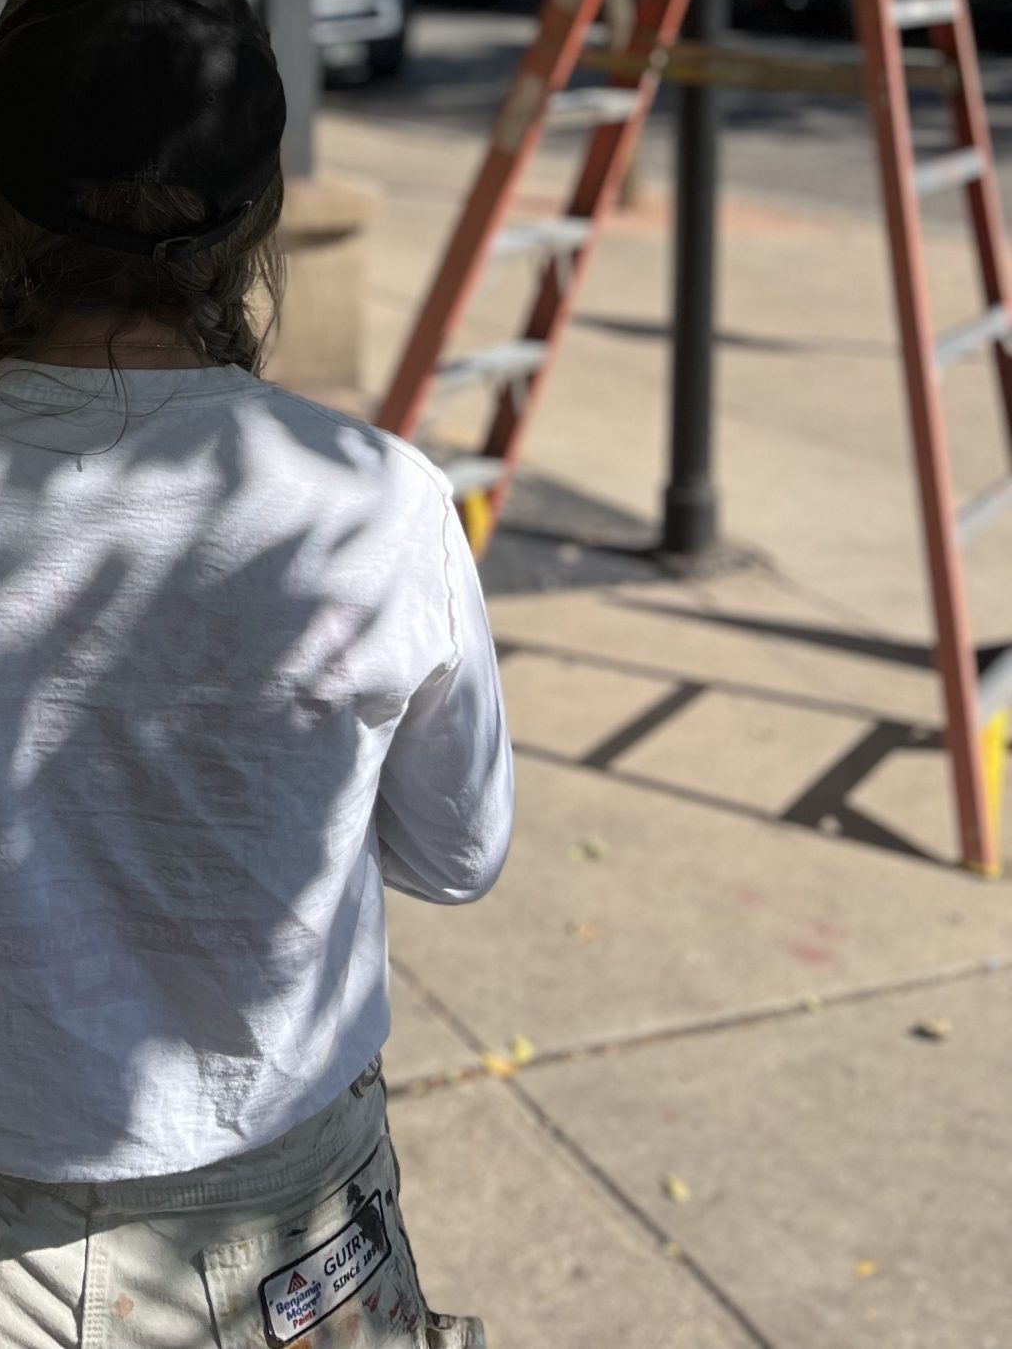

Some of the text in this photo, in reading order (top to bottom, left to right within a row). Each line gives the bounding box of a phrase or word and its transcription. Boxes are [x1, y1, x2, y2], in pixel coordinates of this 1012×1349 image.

[332, 1261, 361, 1293] SINCE
[275, 1280, 322, 1315] Benjamin
[292, 1308, 317, 1329] Paints
